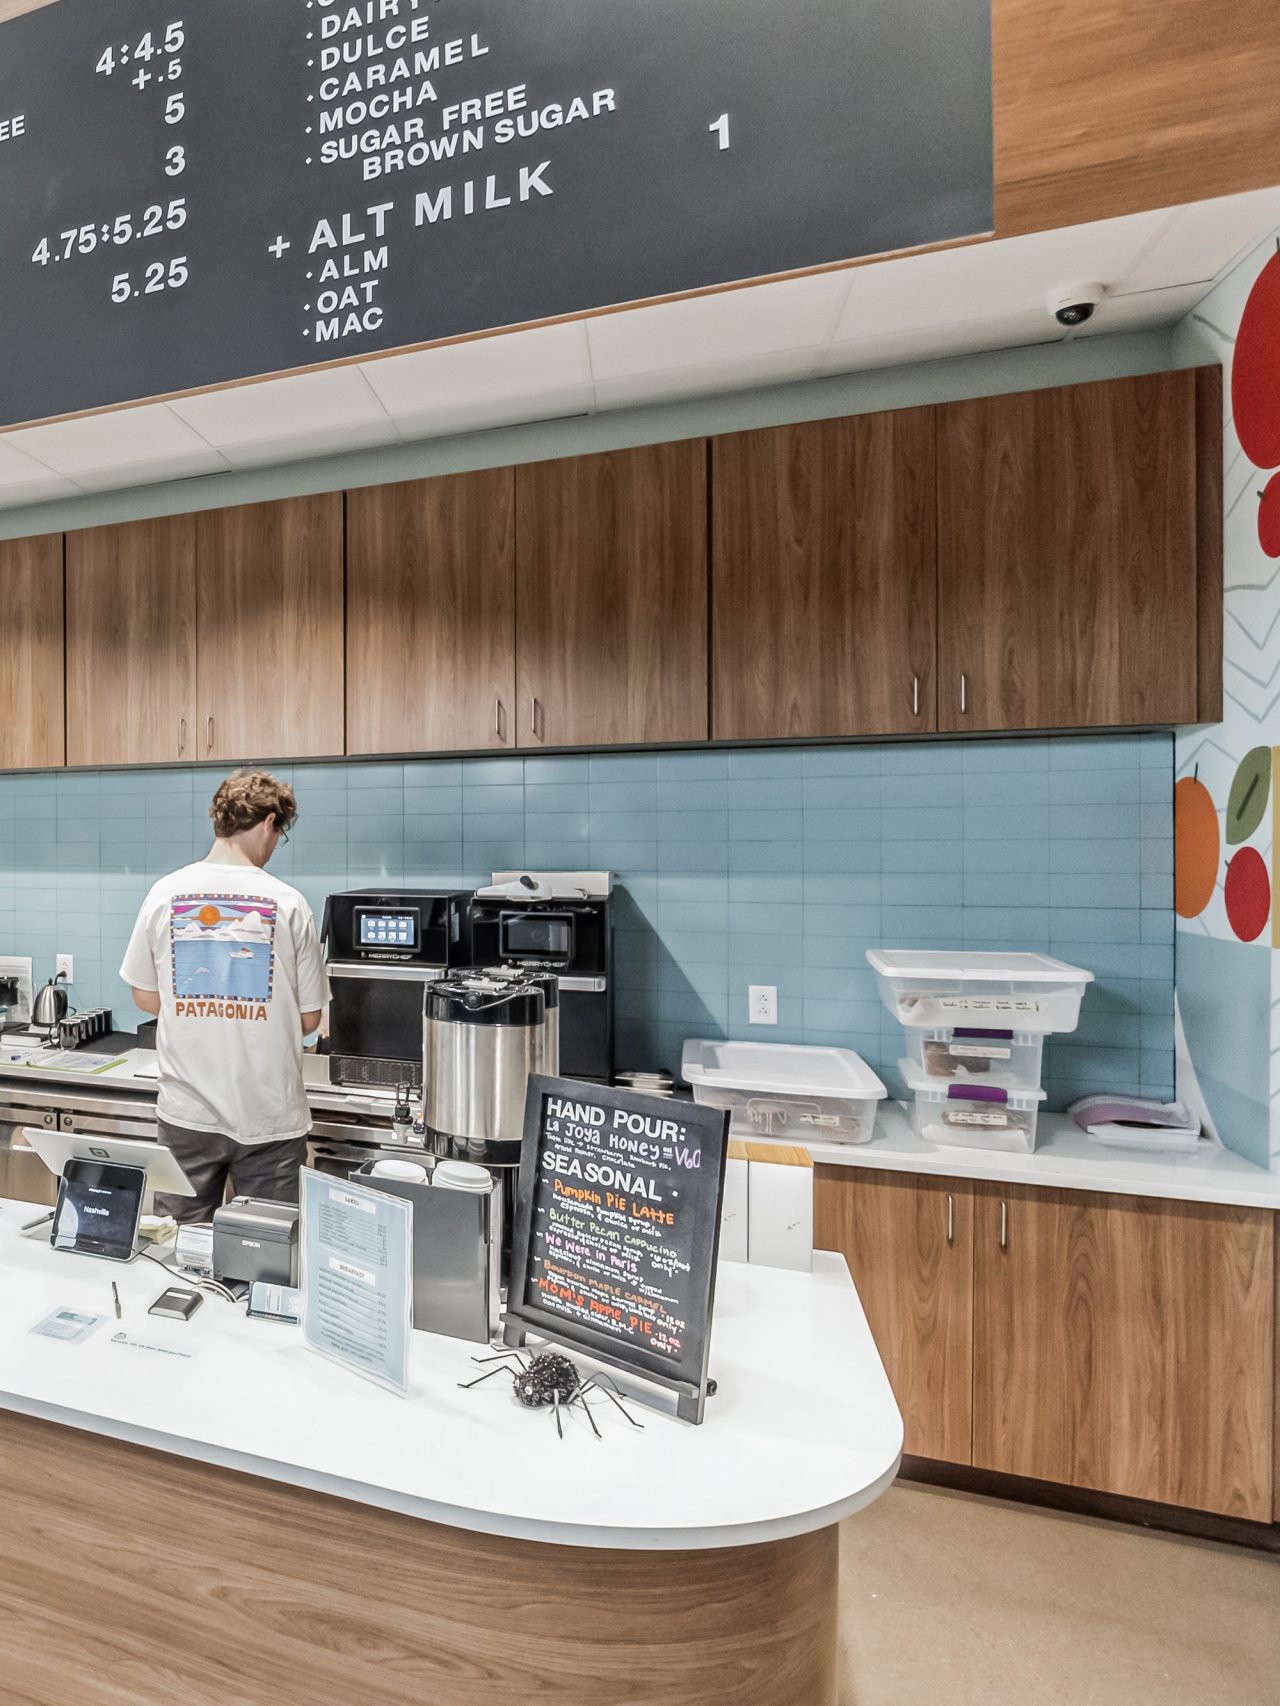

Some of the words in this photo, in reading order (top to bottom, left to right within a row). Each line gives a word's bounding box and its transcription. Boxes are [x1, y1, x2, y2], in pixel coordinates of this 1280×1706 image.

[95, 20, 185, 76] 4:4.5
[321, 15, 429, 71] DULCE
[318, 34, 490, 102] CARAMEL
[164, 93, 185, 124] 5
[319, 80, 438, 134] MOCHA
[320, 117, 424, 165] SUGAR
[442, 84, 528, 130] FREE
[363, 126, 485, 181] BROWN
[494, 88, 617, 144] SUGAR
[708, 113, 731, 151] 1
[164, 145, 185, 176] 3
[307, 201, 394, 254] ALT
[414, 160, 555, 227] MILK
[31, 198, 187, 266] 4.75:5.25
[111, 256, 189, 303] 5.25
[319, 247, 389, 284] ALM
[317, 280, 379, 313] OAT
[315, 307, 384, 343] MAC
[175, 1001, 268, 1021] PATAGONIA
[546, 1118, 559, 1132] La
[547, 1097, 606, 1126] HAND
[613, 1109, 686, 1143] POUR:
[542, 1151, 662, 1202] SEASONAL
[83, 1206, 110, 1217] Nashville
[549, 1208, 585, 1229] Butter
[241, 1239, 261, 1248] EPSON
[545, 1232, 562, 1247] We
[565, 1239, 591, 1256] Were
[596, 1250, 606, 1262] in
